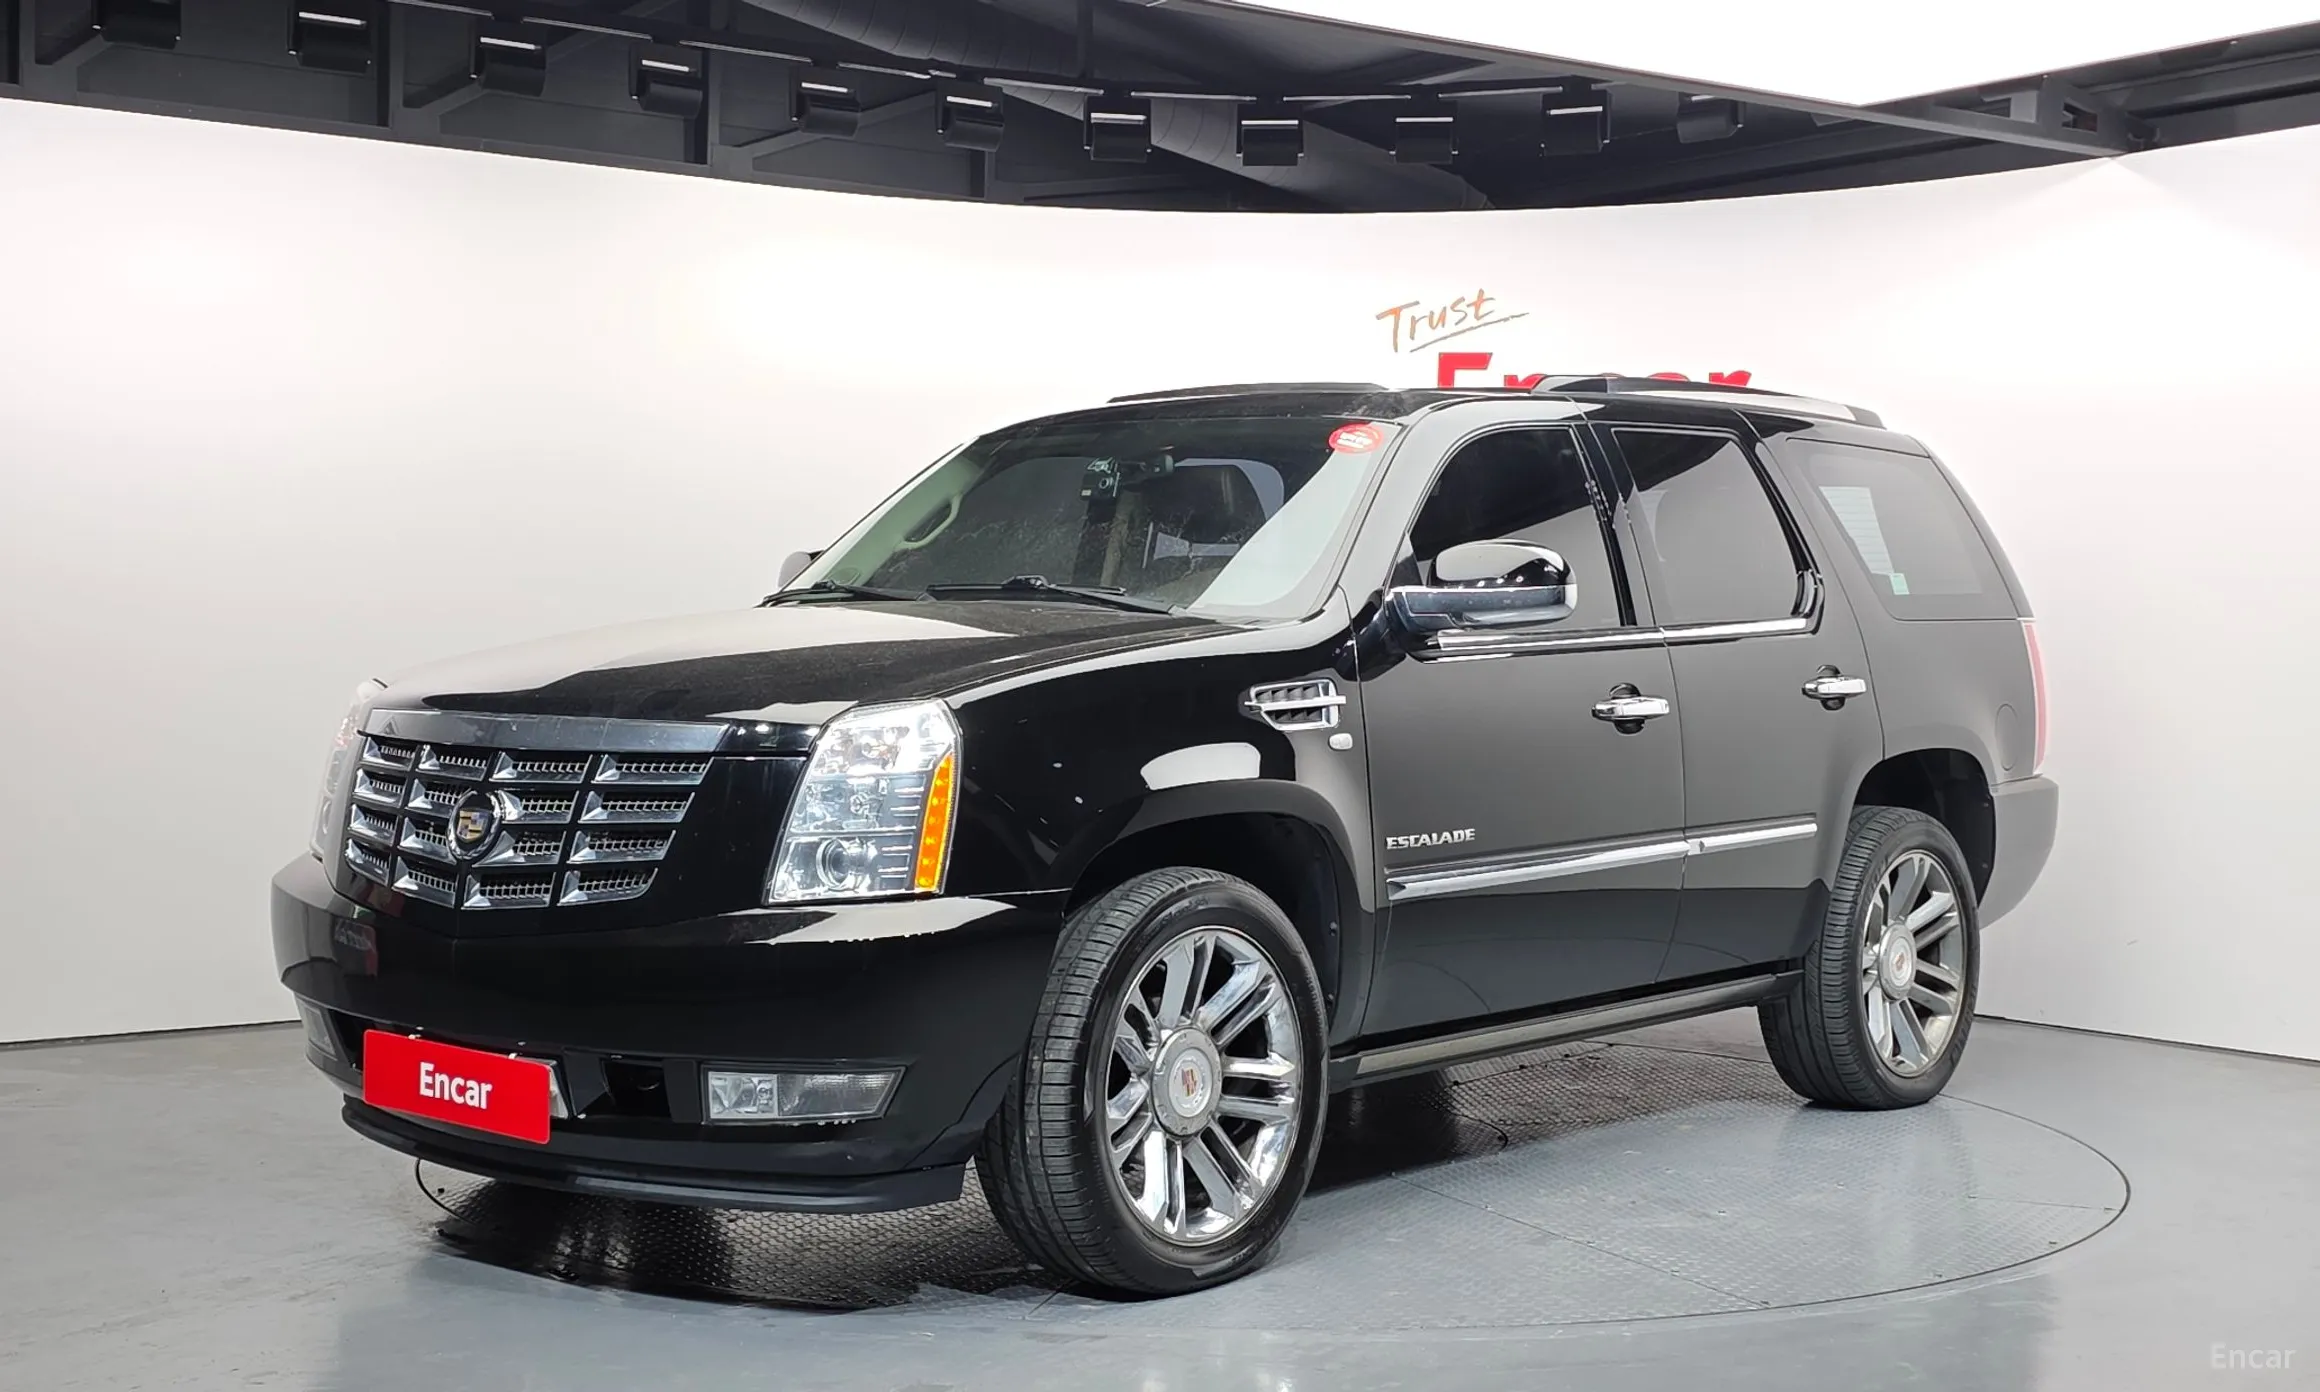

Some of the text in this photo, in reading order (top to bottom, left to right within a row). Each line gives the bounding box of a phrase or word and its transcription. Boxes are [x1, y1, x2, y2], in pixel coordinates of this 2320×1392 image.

[1376, 288, 1496, 353] Trust
[1386, 828, 1476, 850] ESCALADE
[419, 1061, 493, 1110] Encar
